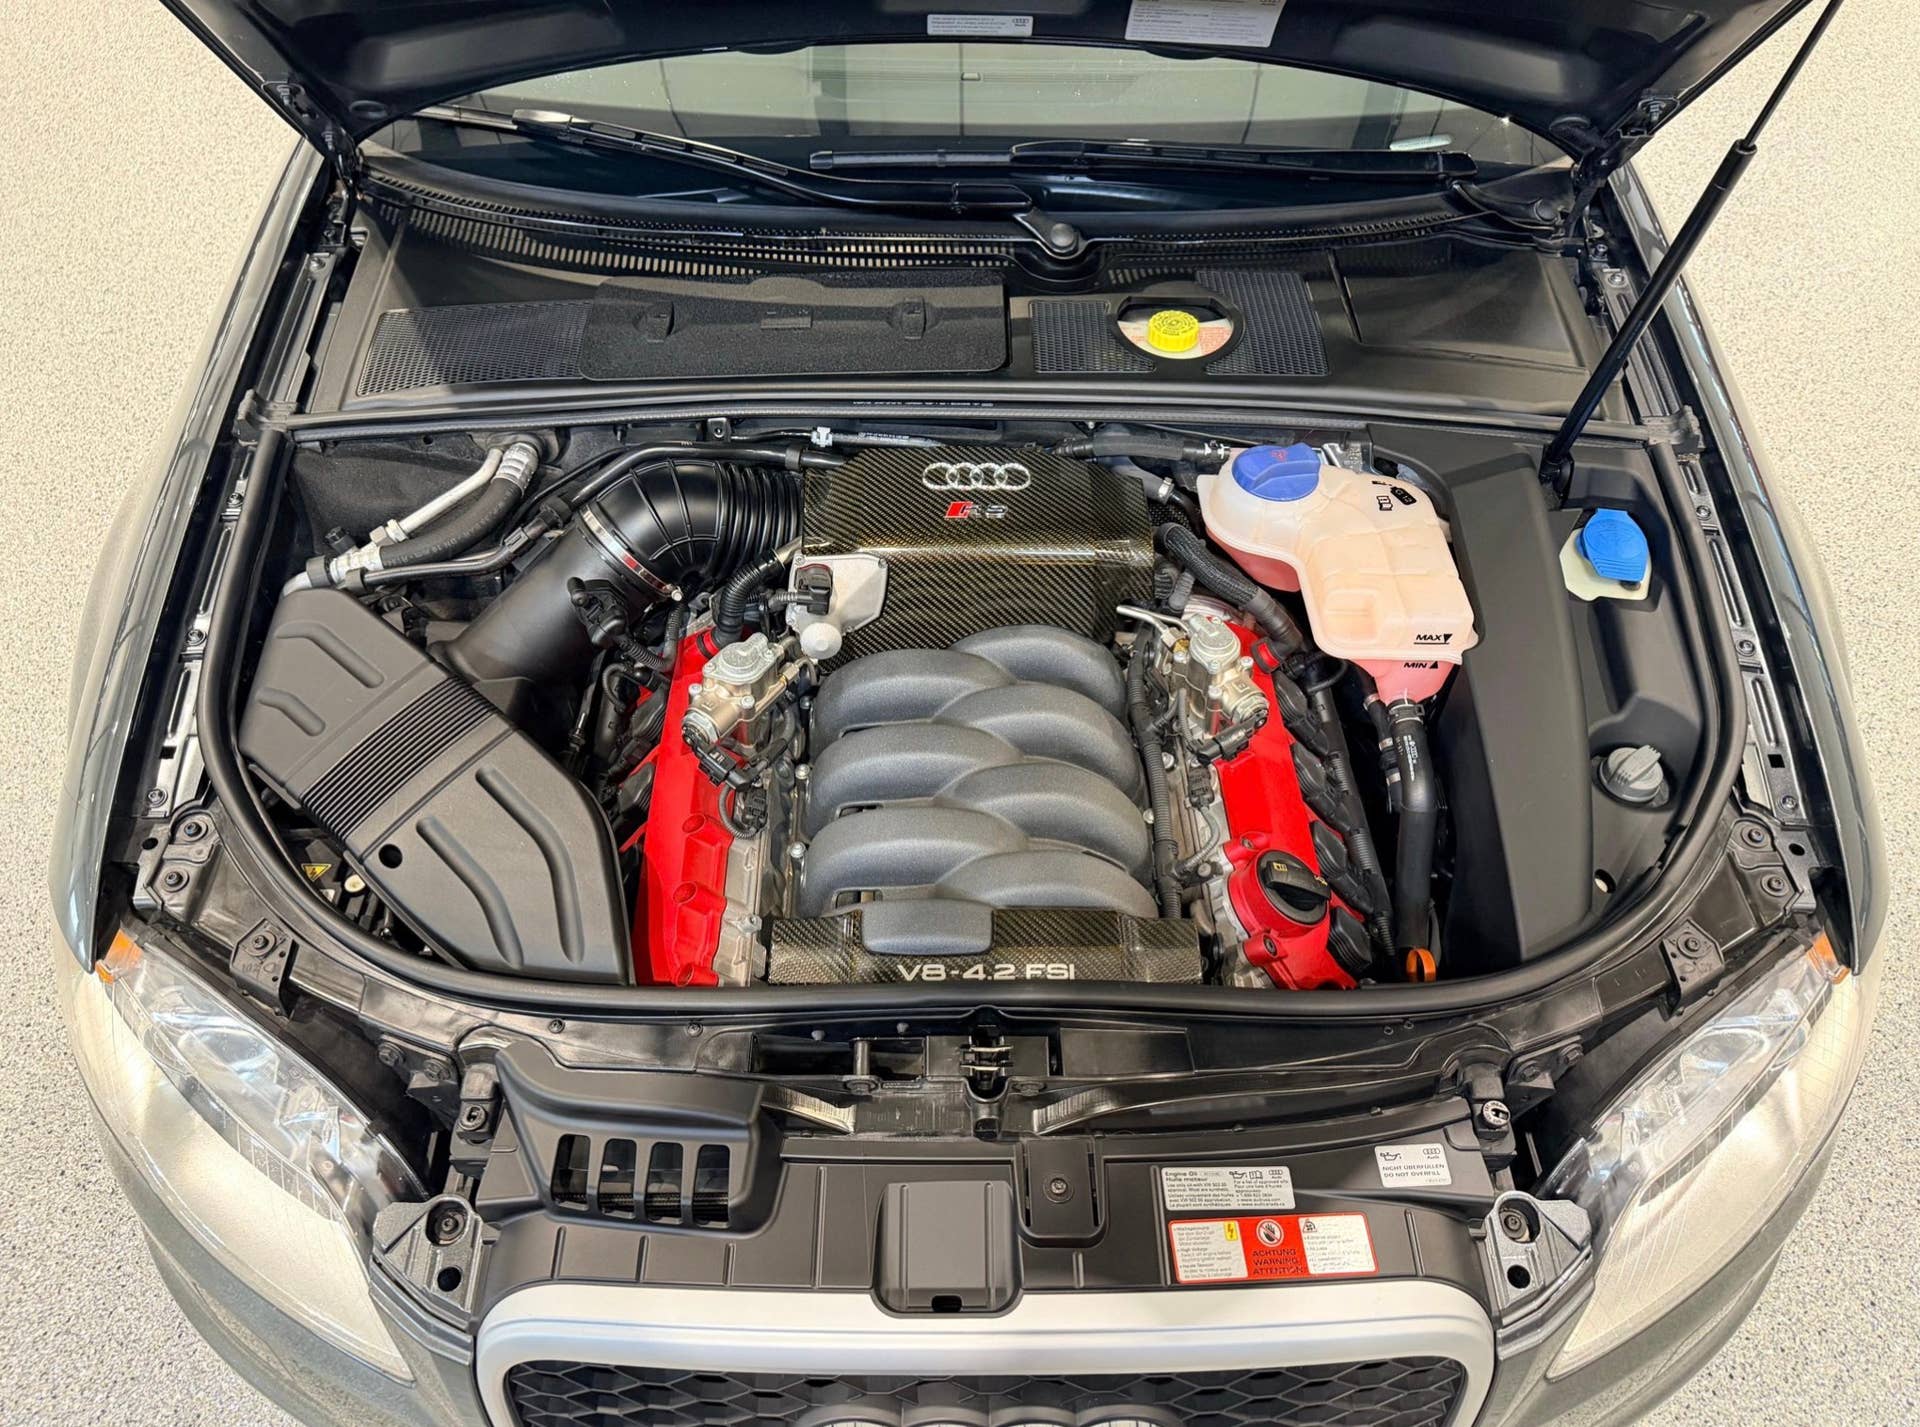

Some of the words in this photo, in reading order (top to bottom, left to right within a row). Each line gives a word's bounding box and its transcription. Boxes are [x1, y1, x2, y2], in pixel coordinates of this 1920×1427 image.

[1025, 963, 1075, 980] FSI
[1253, 1248, 1297, 1257] ACHTUNG
[1253, 1257, 1299, 1266] WARNING
[1253, 1266, 1304, 1275] ATTENTION
